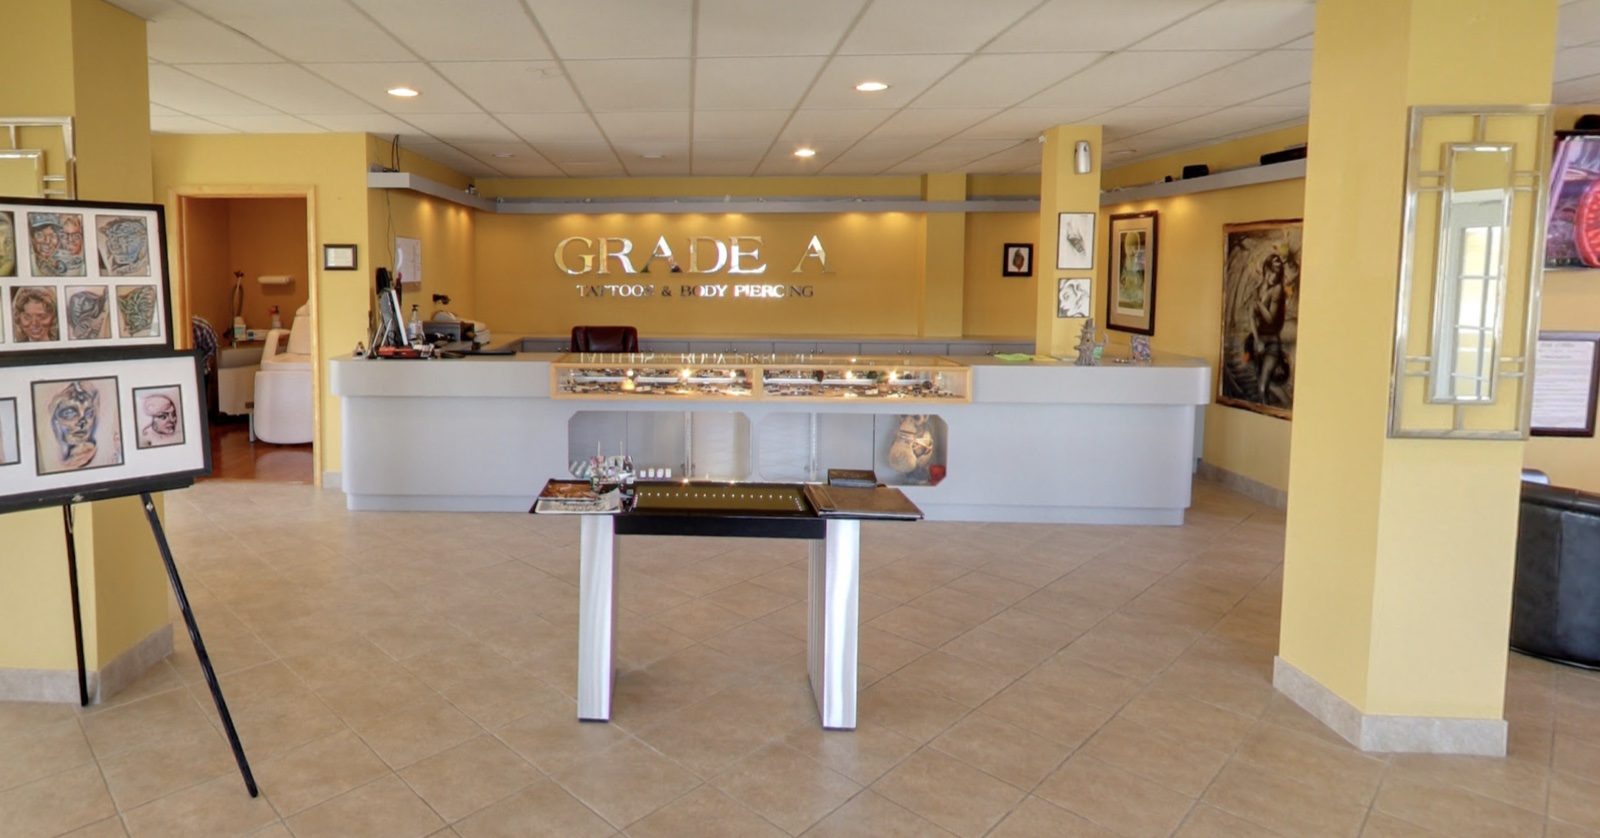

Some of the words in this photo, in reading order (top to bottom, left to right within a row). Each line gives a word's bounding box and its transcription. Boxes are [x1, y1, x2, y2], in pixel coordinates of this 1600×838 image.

[554, 235, 767, 275] GRADE
[791, 234, 834, 273] A
[576, 284, 654, 297] TATTOOS
[661, 285, 672, 297] &
[681, 284, 728, 297] BODY
[734, 284, 814, 298] PIERCNG
